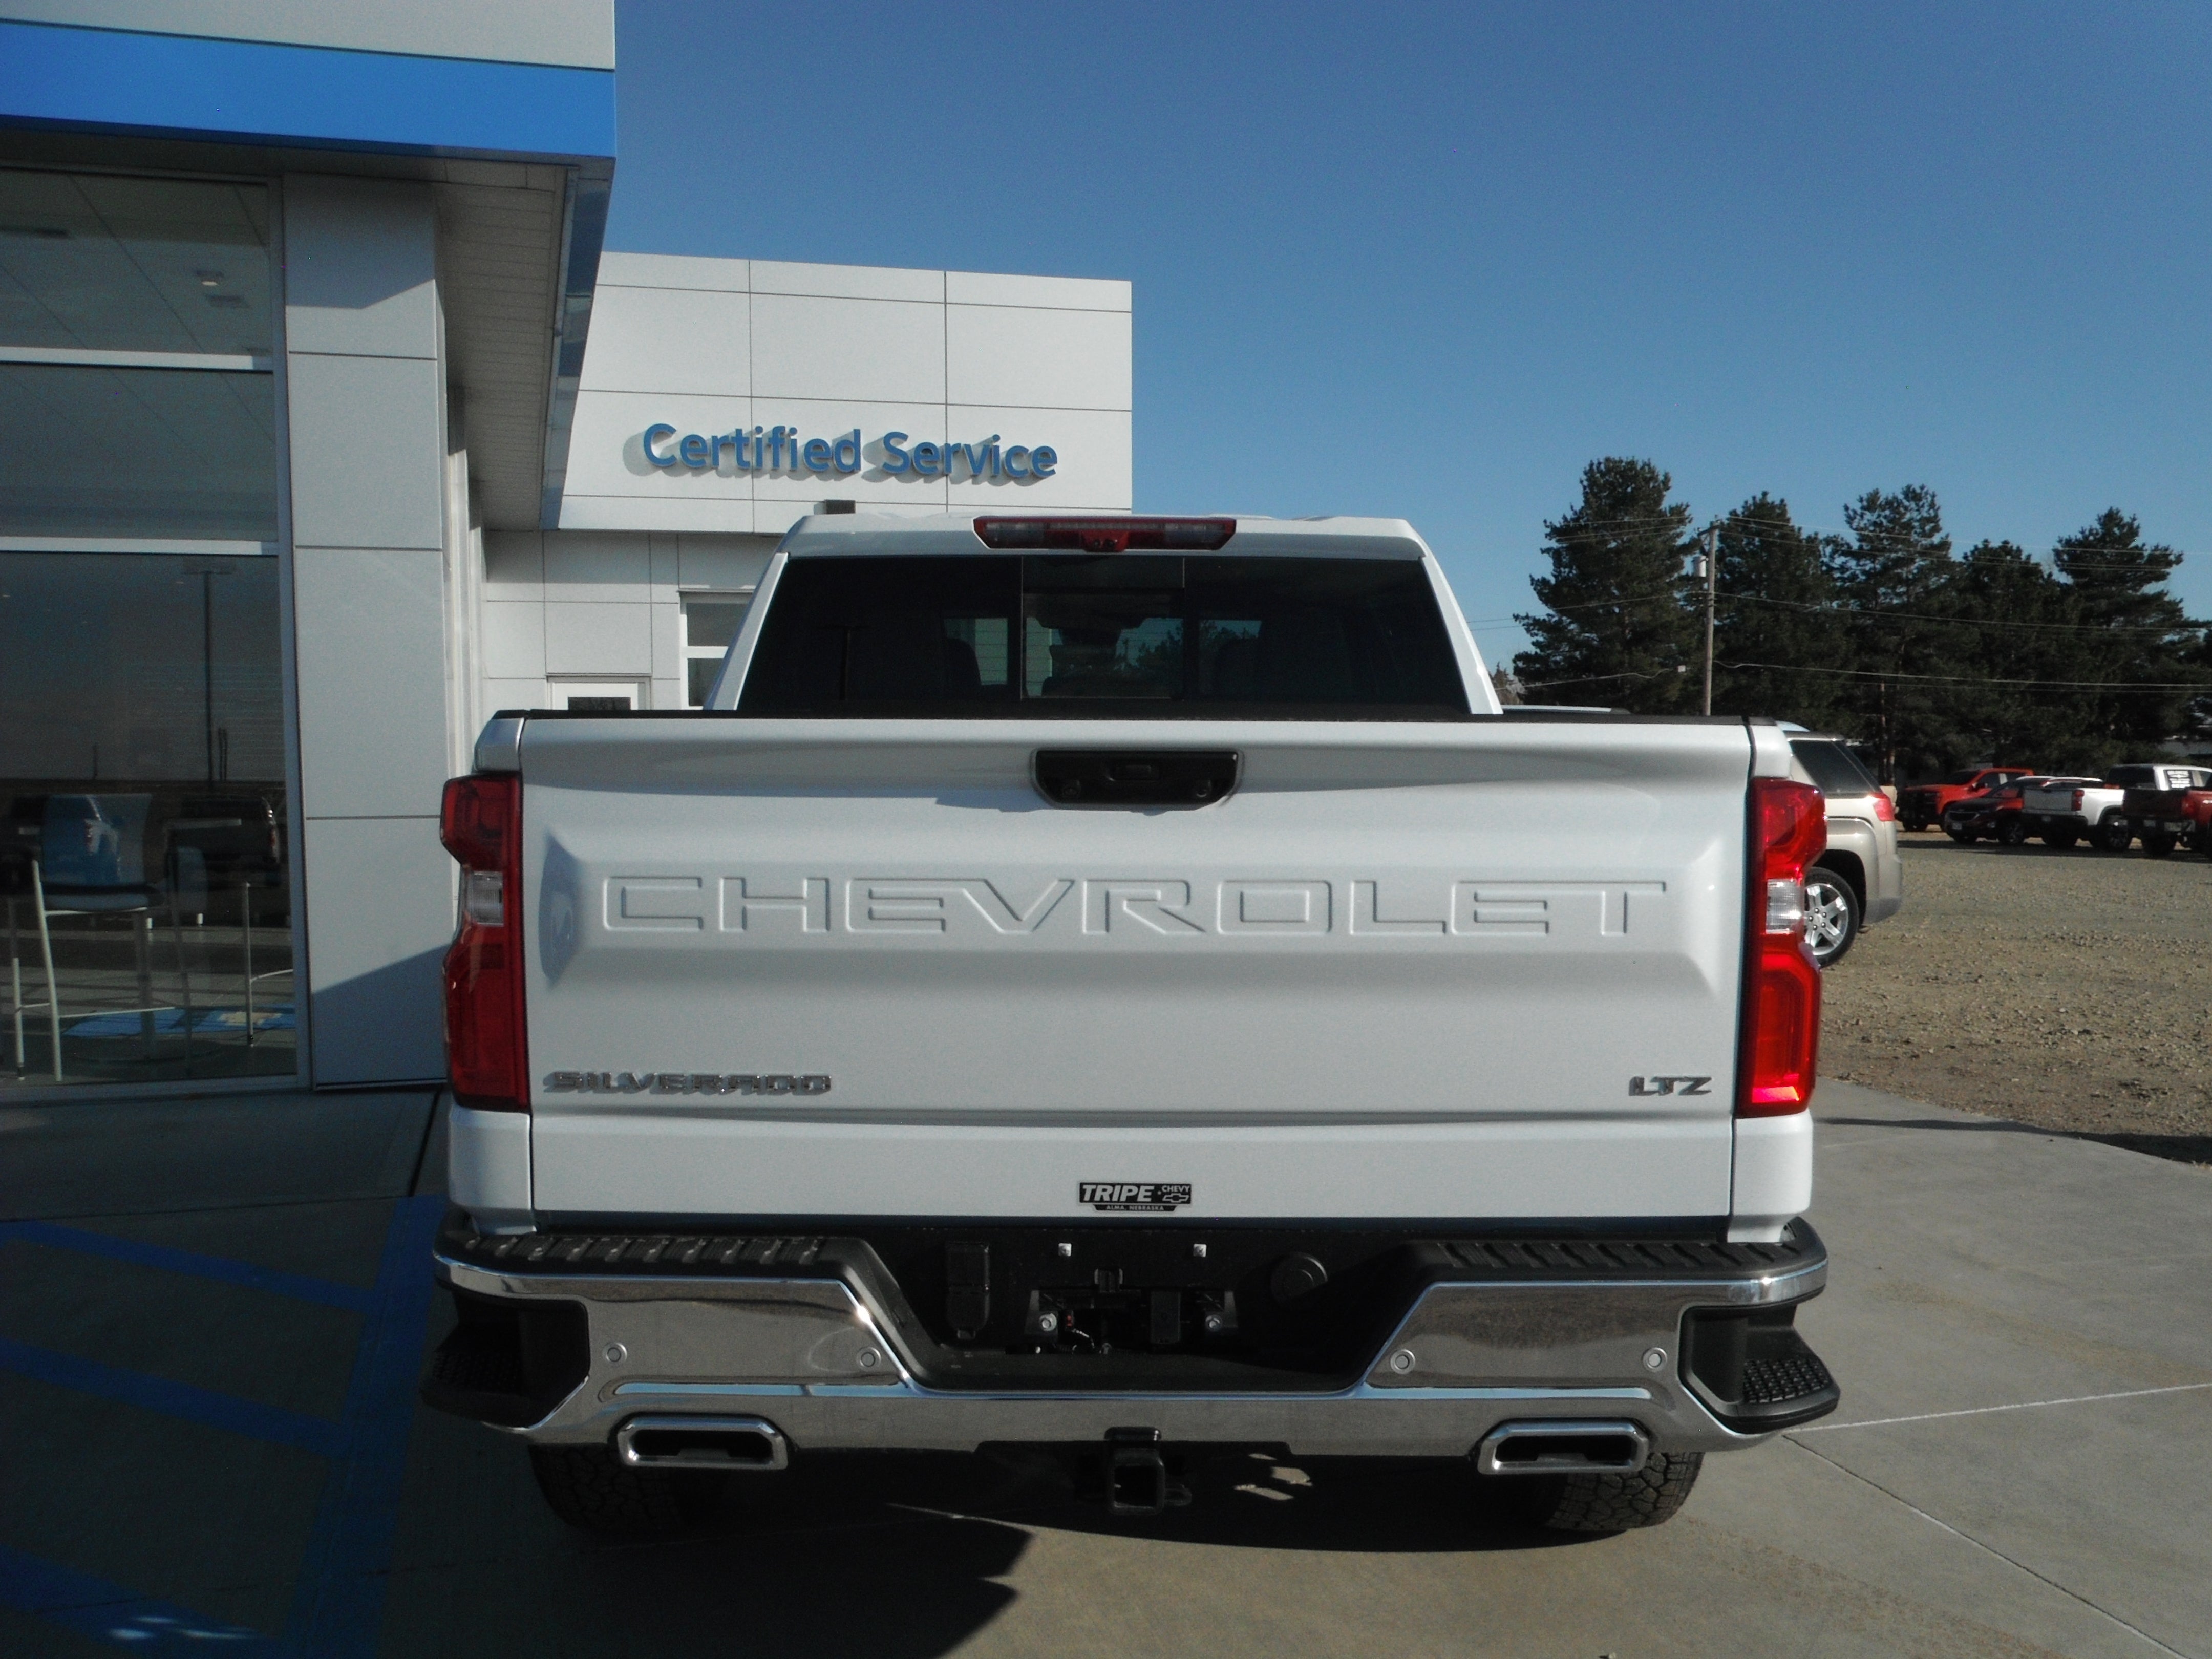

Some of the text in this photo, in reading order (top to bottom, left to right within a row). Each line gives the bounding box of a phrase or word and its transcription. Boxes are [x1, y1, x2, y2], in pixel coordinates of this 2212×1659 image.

[643, 423, 1058, 477] Certified Service
[603, 877, 1667, 935] CHEVROLET
[546, 1072, 832, 1094] SILVERADO
[1628, 1076, 1712, 1096] LTZ
[1082, 1185, 1154, 1202] TRIPE
